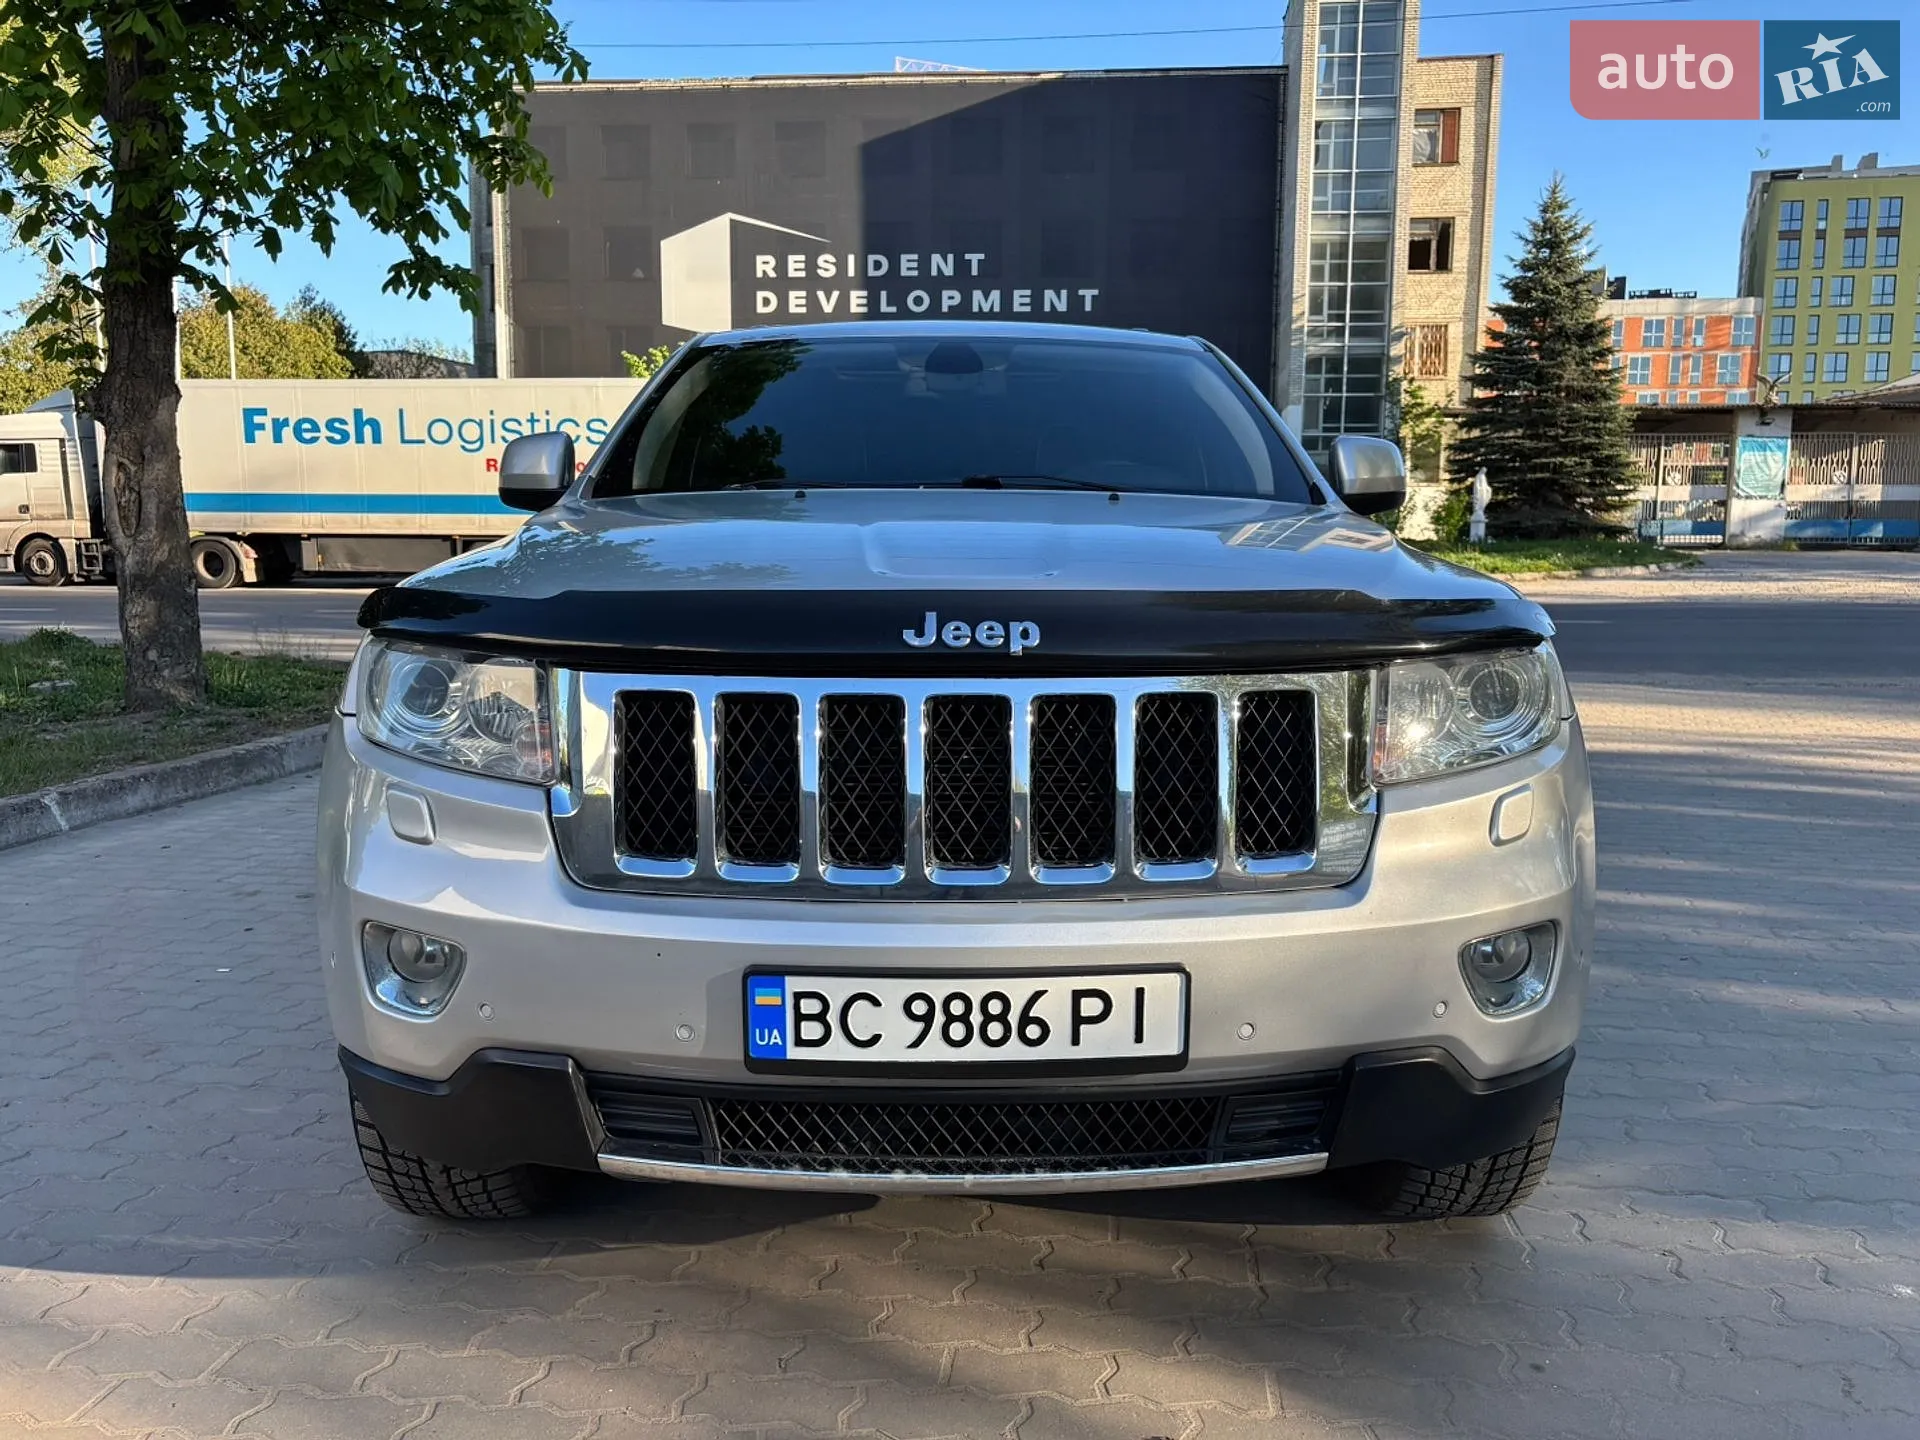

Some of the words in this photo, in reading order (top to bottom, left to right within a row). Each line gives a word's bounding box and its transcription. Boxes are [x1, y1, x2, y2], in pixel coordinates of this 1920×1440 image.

[755, 253, 986, 278] RESIDENT
[755, 289, 1100, 314] DEVELOPMENT
[242, 407, 382, 445] Fresh
[398, 407, 609, 453] Logistics
[902, 611, 1041, 656] Jeep
[793, 990, 883, 1048] BC
[902, 990, 1052, 1049] 9886
[1070, 986, 1146, 1046] PI
[755, 1027, 783, 1047] UA
